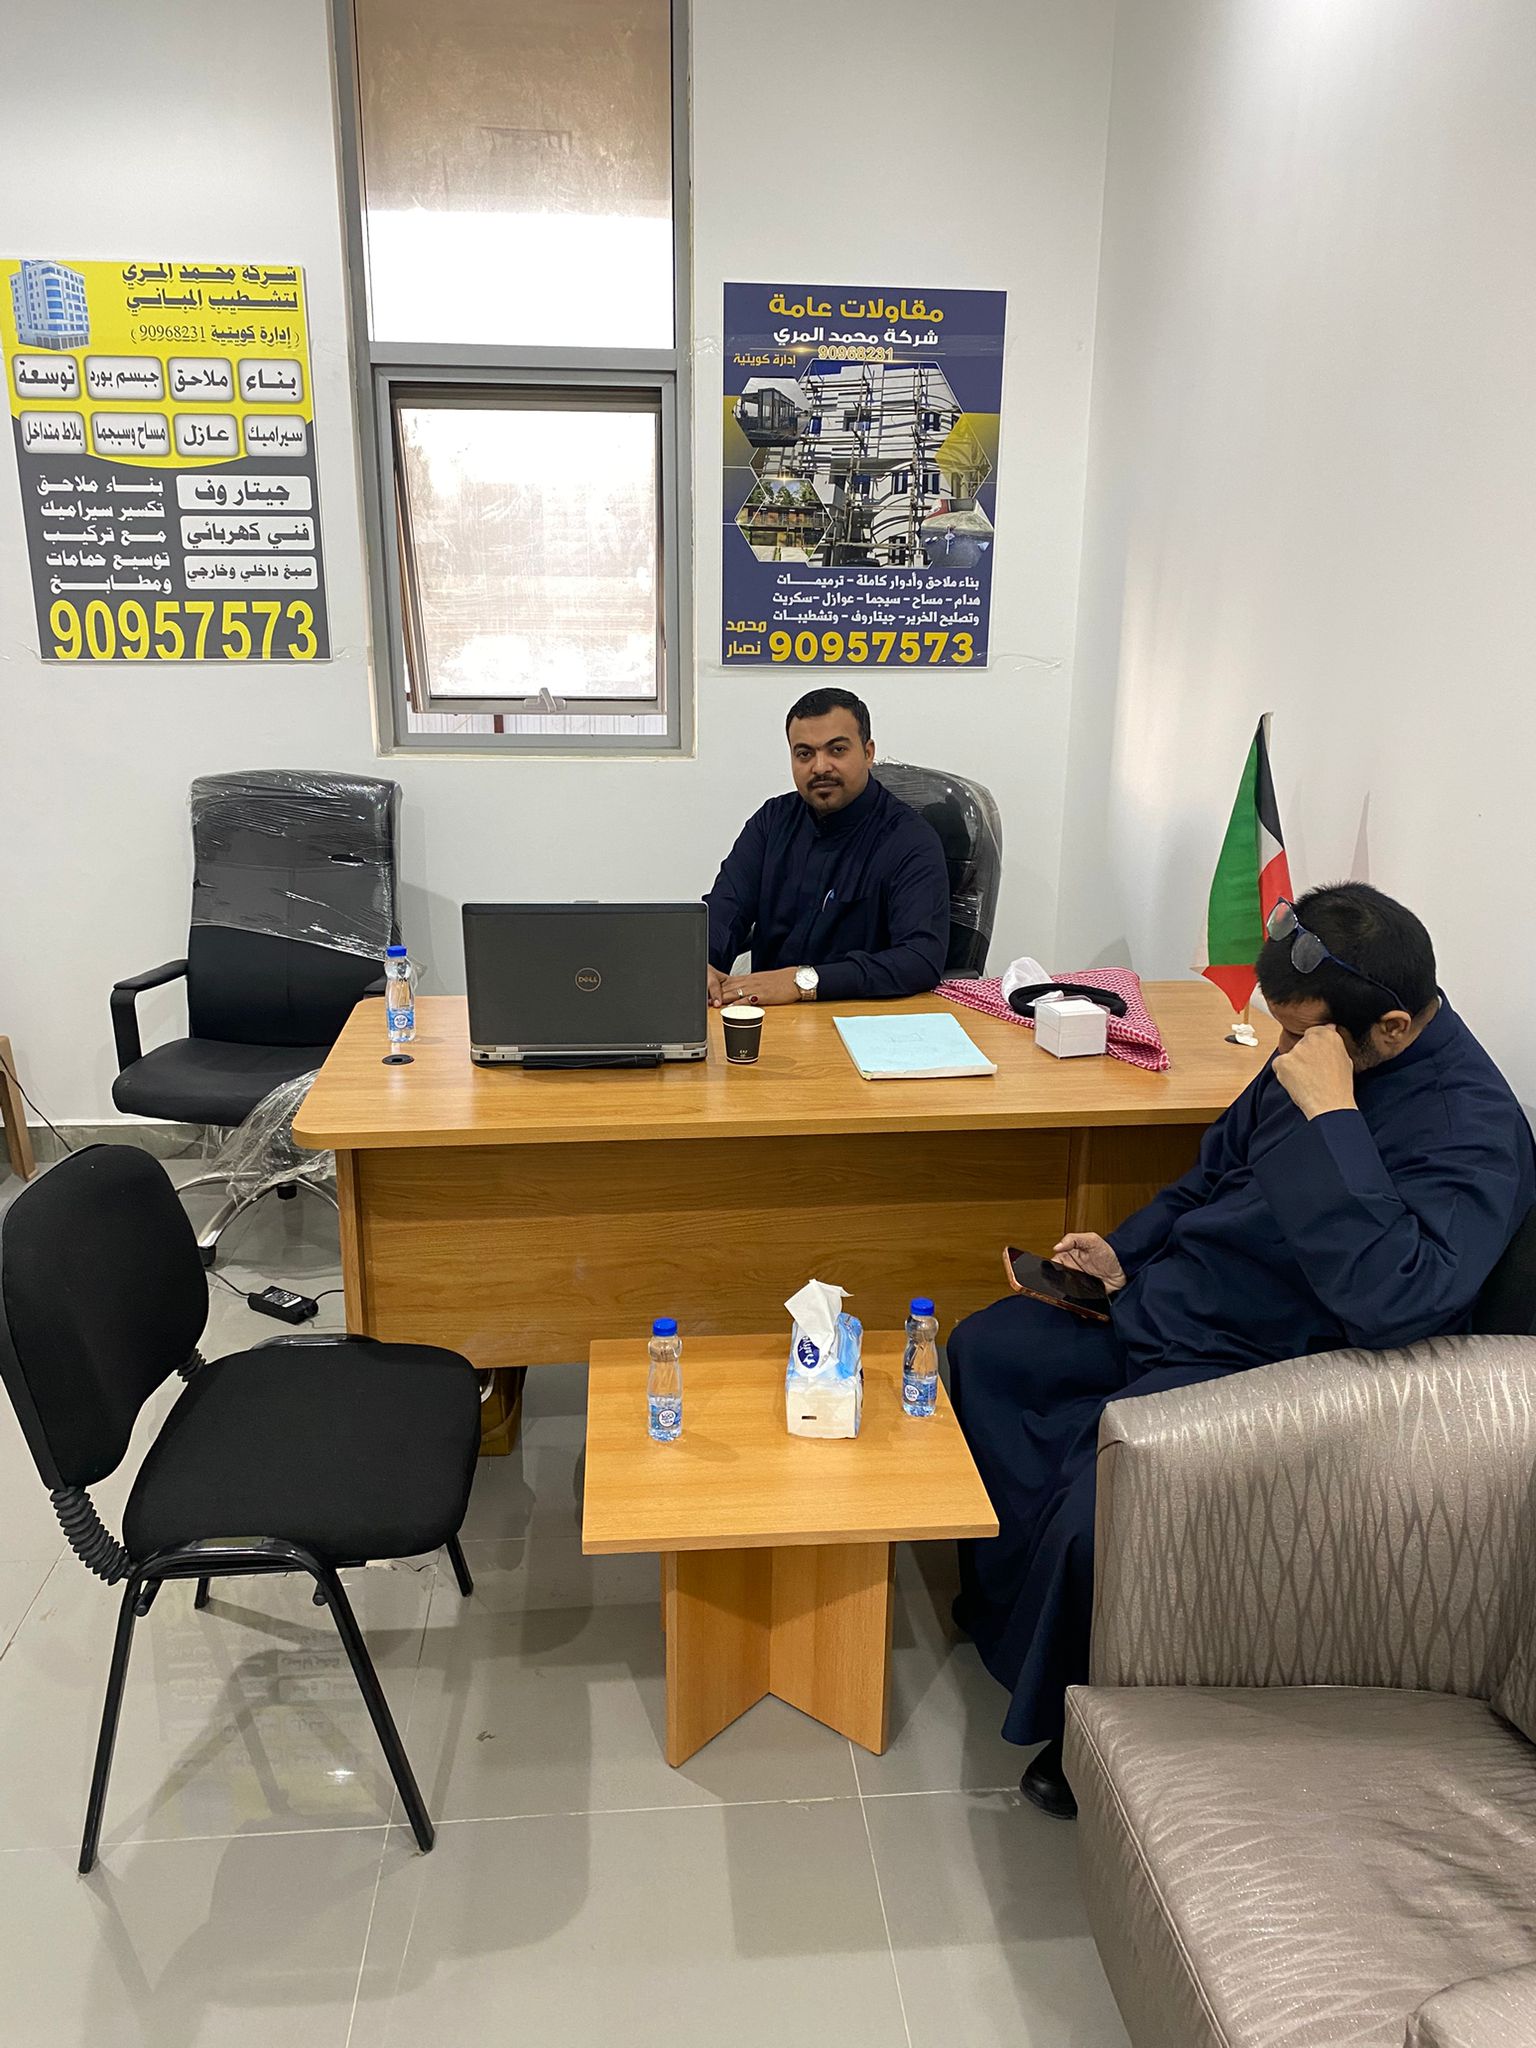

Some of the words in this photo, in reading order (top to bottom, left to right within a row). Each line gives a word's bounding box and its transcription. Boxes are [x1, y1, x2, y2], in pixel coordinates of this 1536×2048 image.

[122, 262, 173, 288] المري
[180, 265, 236, 283] محمد
[127, 288, 202, 314] المباني
[208, 290, 298, 313] لتشطيب
[768, 293, 833, 318] عامة
[839, 298, 945, 324] مقاولات
[139, 324, 206, 342] 90968231
[211, 325, 255, 345] كويتية
[773, 327, 824, 346] المري
[828, 332, 879, 345] محمد
[884, 327, 939, 347] شركة
[733, 353, 770, 365] كويتية
[772, 354, 796, 368] إدارة
[817, 344, 894, 362] 90968231
[18, 360, 75, 392] توسعة
[90, 370, 112, 387] بورد
[116, 370, 159, 388] جبسم
[174, 369, 228, 392] ملاحق
[246, 368, 297, 396] بناء
[62, 421, 83, 447] بلاط
[95, 421, 135, 446] وسيجما
[137, 421, 166, 449] مساح
[183, 424, 229, 446] عازل
[248, 425, 303, 447] سيراميك
[36, 474, 99, 496] ملاحق
[105, 475, 164, 497] بناء
[40, 499, 114, 521] سيراميك
[117, 500, 166, 521] تكسير
[43, 524, 115, 546] تركيب
[120, 530, 167, 546] مع
[187, 521, 261, 549] كهربائي
[267, 523, 310, 549] فني
[46, 549, 106, 567] حمامات
[112, 551, 171, 571] توسيع
[187, 563, 236, 582] وخارجي
[240, 564, 279, 582] داخلي
[283, 564, 312, 580] صبغ
[776, 573, 844, 588] ترميمات
[856, 574, 888, 587] كاملة
[889, 571, 923, 590] وأدوار
[50, 573, 173, 595] ومطابخ
[925, 576, 957, 590] ملاحق
[958, 576, 980, 591] بناء
[822, 592, 854, 606] عوازل
[865, 592, 901, 607] سيجما
[912, 593, 943, 609] مساح
[953, 594, 980, 609] هدام
[725, 620, 767, 633] محمد
[772, 609, 839, 625] وتشطيبات
[939, 611, 980, 627] وتصليح
[50, 599, 318, 660] 90957573
[726, 640, 761, 658] نصار
[768, 630, 975, 663] 90957573
